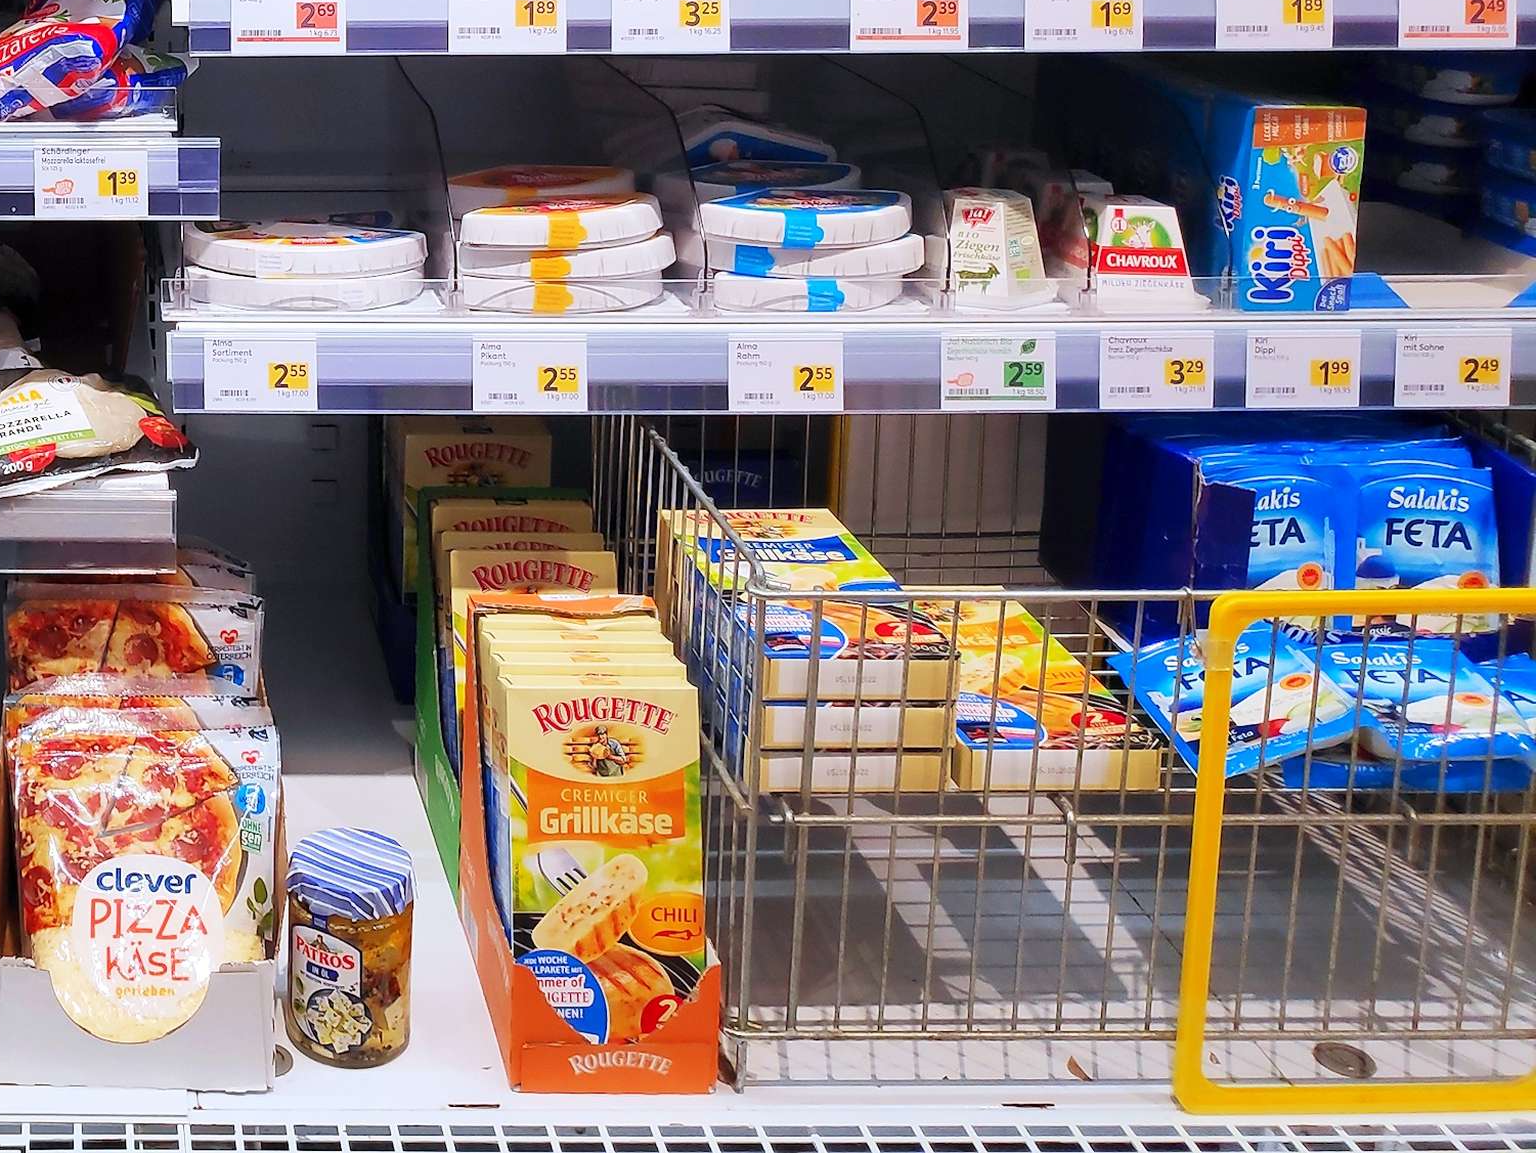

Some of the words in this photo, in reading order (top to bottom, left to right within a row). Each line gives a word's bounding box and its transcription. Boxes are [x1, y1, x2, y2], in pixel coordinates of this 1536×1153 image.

[1106, 252, 1178, 269] CHAVROUX
[1247, 226, 1298, 303] Kiri
[1288, 235, 1311, 281] Dippi
[212, 349, 252, 357] Sortiment
[1255, 345, 1275, 355] Dippi
[472, 560, 594, 593] ROUGETTE
[532, 695, 674, 735] ROUGETTE
[561, 789, 648, 803] CREMIGER
[540, 806, 673, 836] Grillkäse
[90, 898, 208, 940] PIZZA
[651, 905, 697, 922] CHILI
